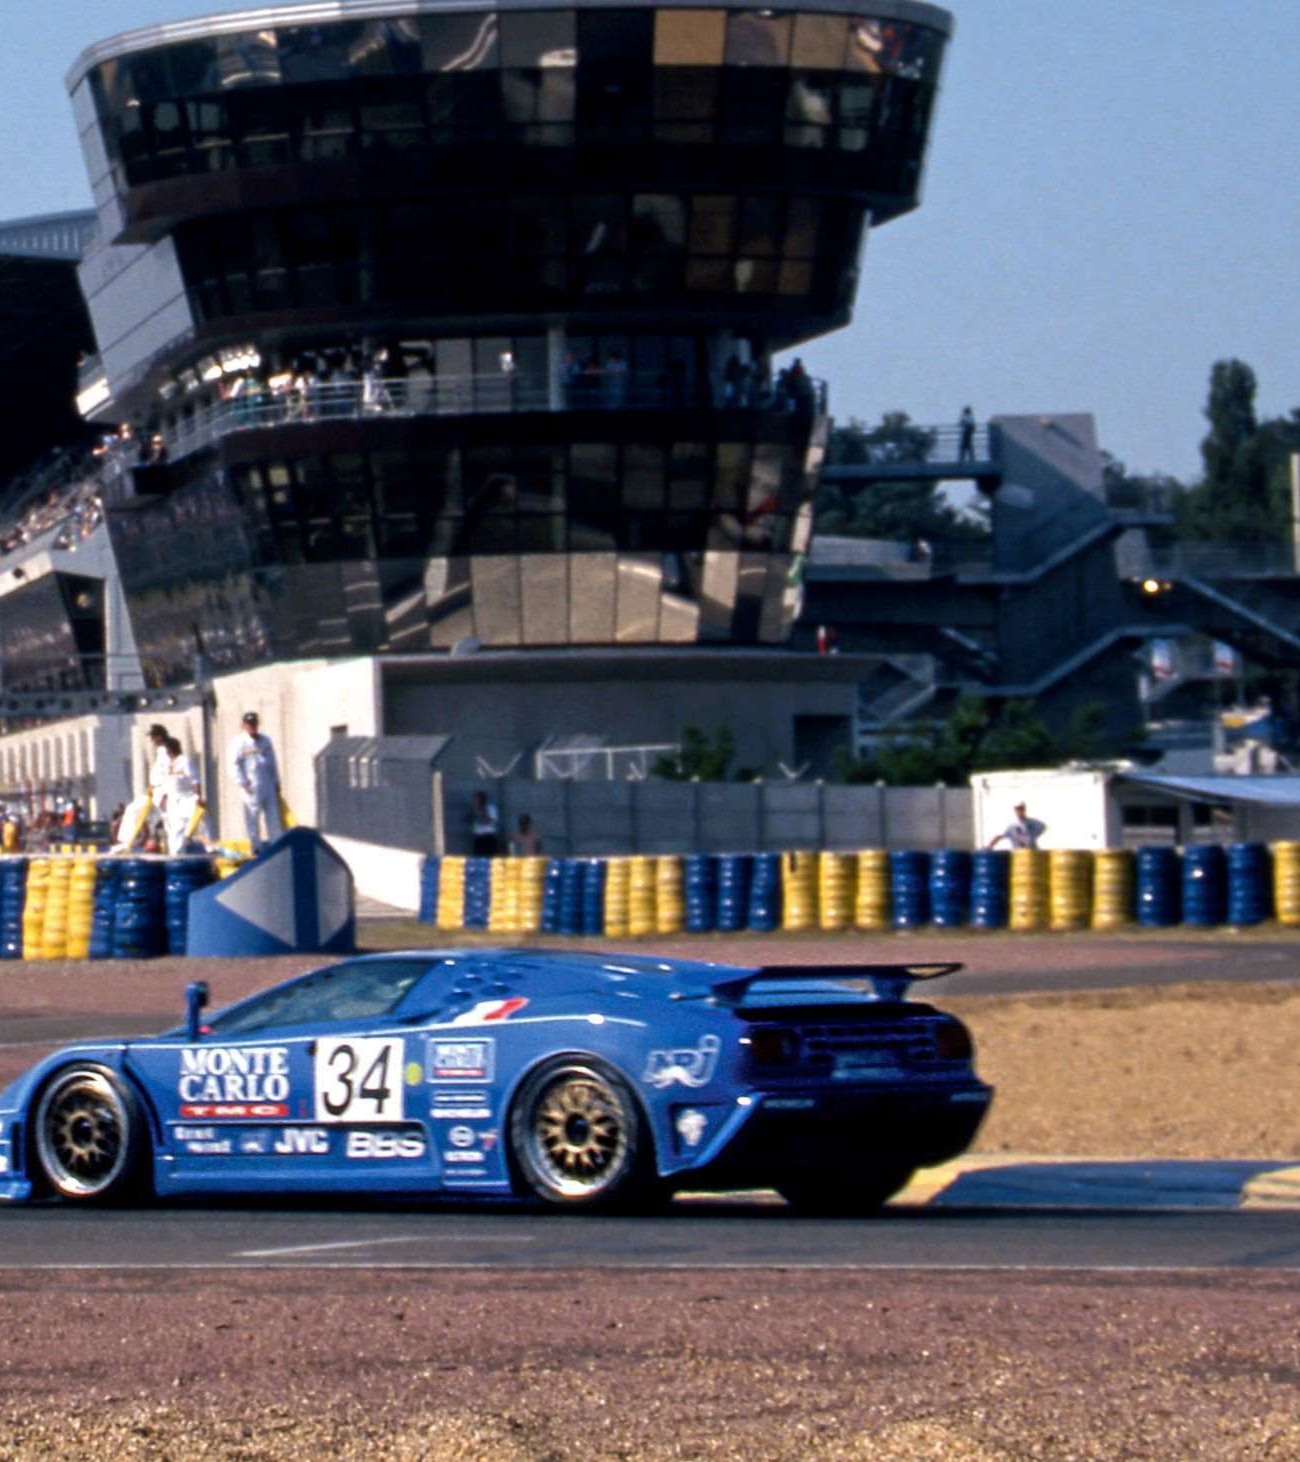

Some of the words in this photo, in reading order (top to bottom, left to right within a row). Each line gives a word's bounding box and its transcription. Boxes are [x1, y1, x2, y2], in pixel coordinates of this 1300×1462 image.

[180, 1047, 289, 1075] MONTE
[179, 1074, 290, 1101] CARLO
[323, 1044, 392, 1116] 34
[275, 1128, 329, 1153] JVC
[347, 1131, 426, 1157] BBS
